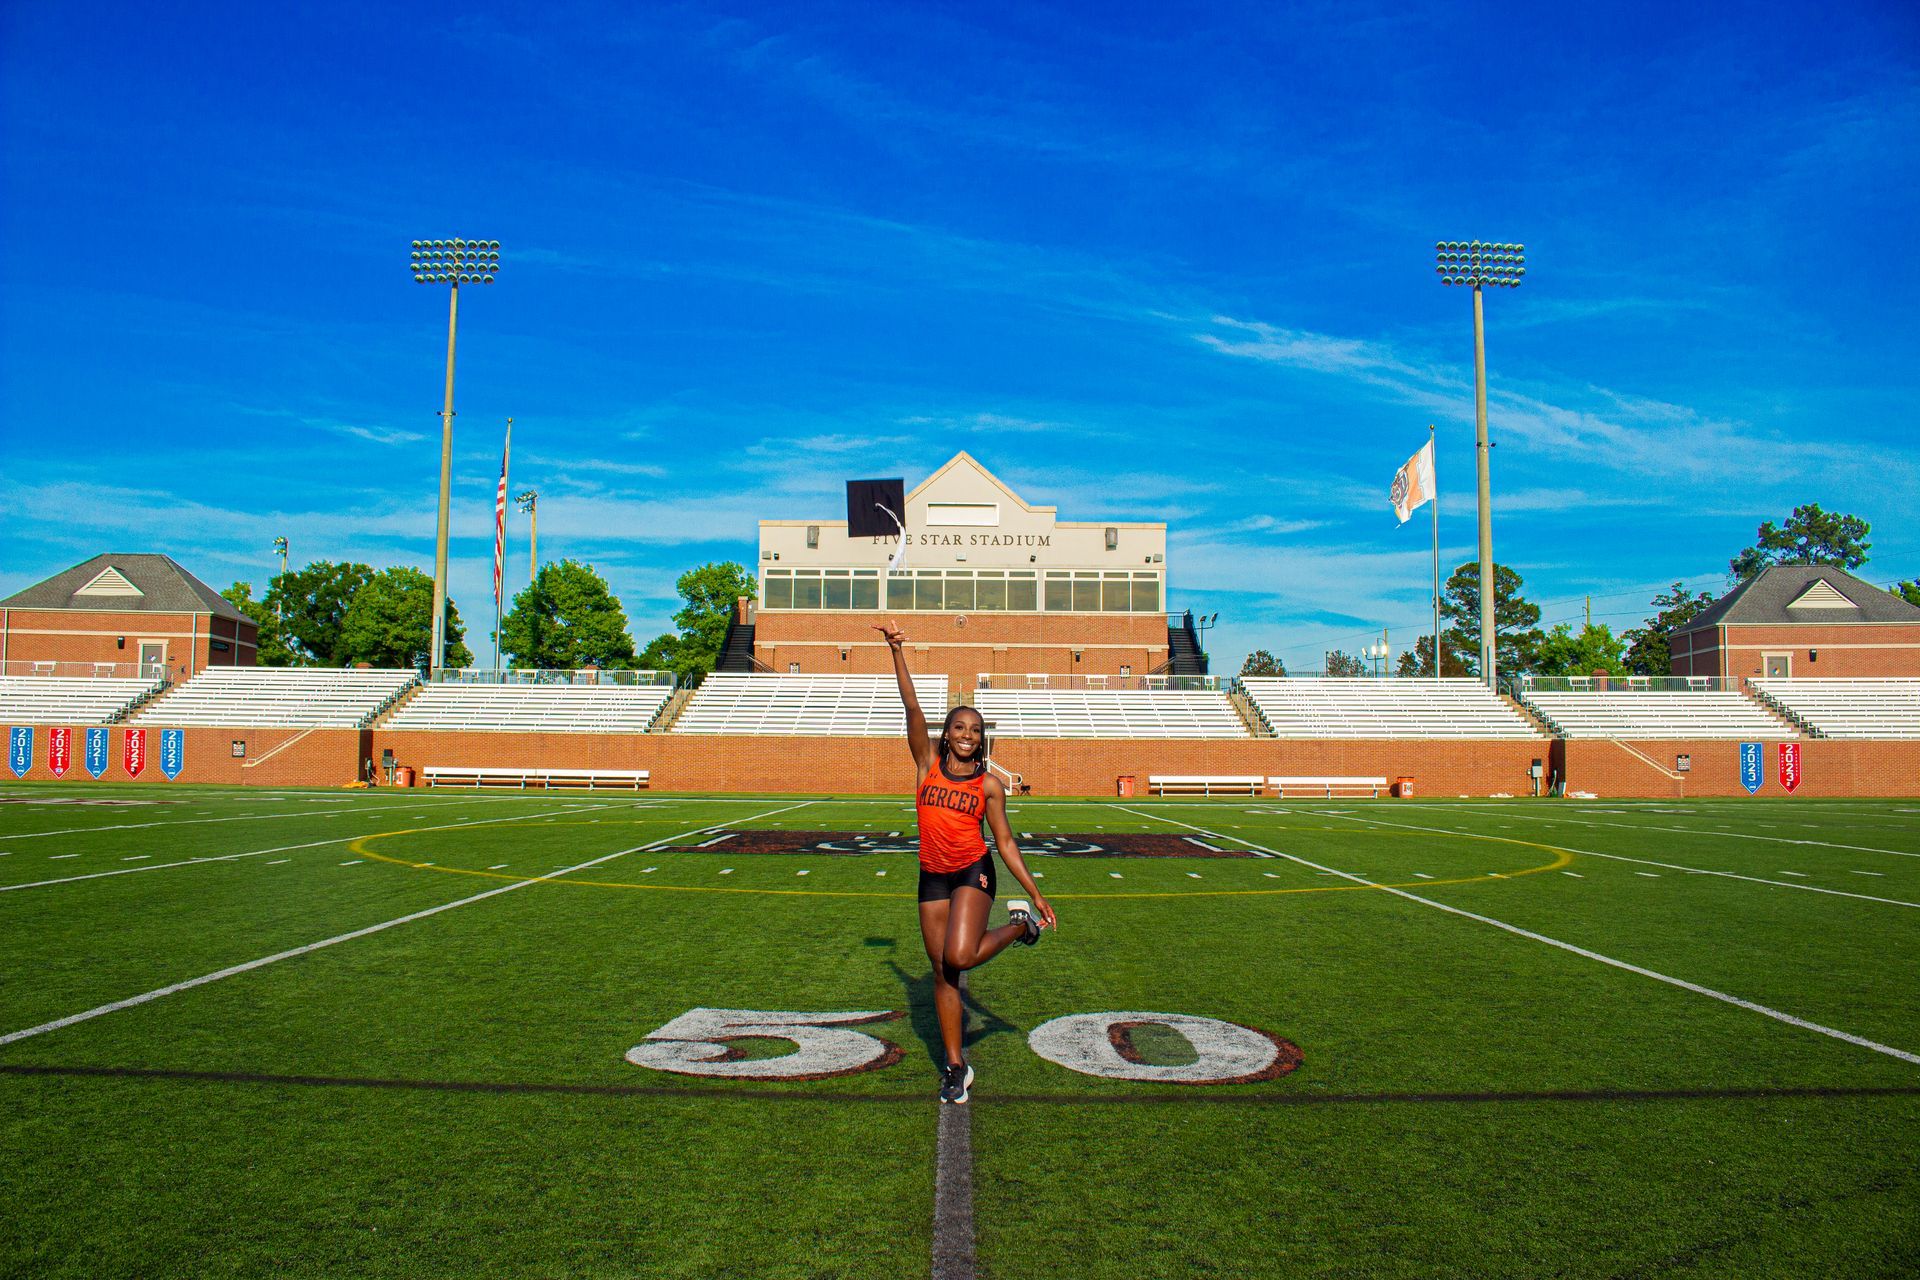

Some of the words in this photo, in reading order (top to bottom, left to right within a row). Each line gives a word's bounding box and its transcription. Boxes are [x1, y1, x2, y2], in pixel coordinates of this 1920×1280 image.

[872, 534, 913, 545] FIVE
[920, 534, 963, 546] STAR
[970, 534, 1051, 547] STADIUM
[17, 728, 27, 766] 2019
[55, 729, 65, 767] 2021
[92, 729, 102, 766] 2021
[130, 730, 140, 767] 2022
[167, 730, 177, 768] 2022
[1747, 744, 1756, 782] 2023
[1785, 744, 1794, 782] 2023
[918, 784, 980, 817] MERCER
